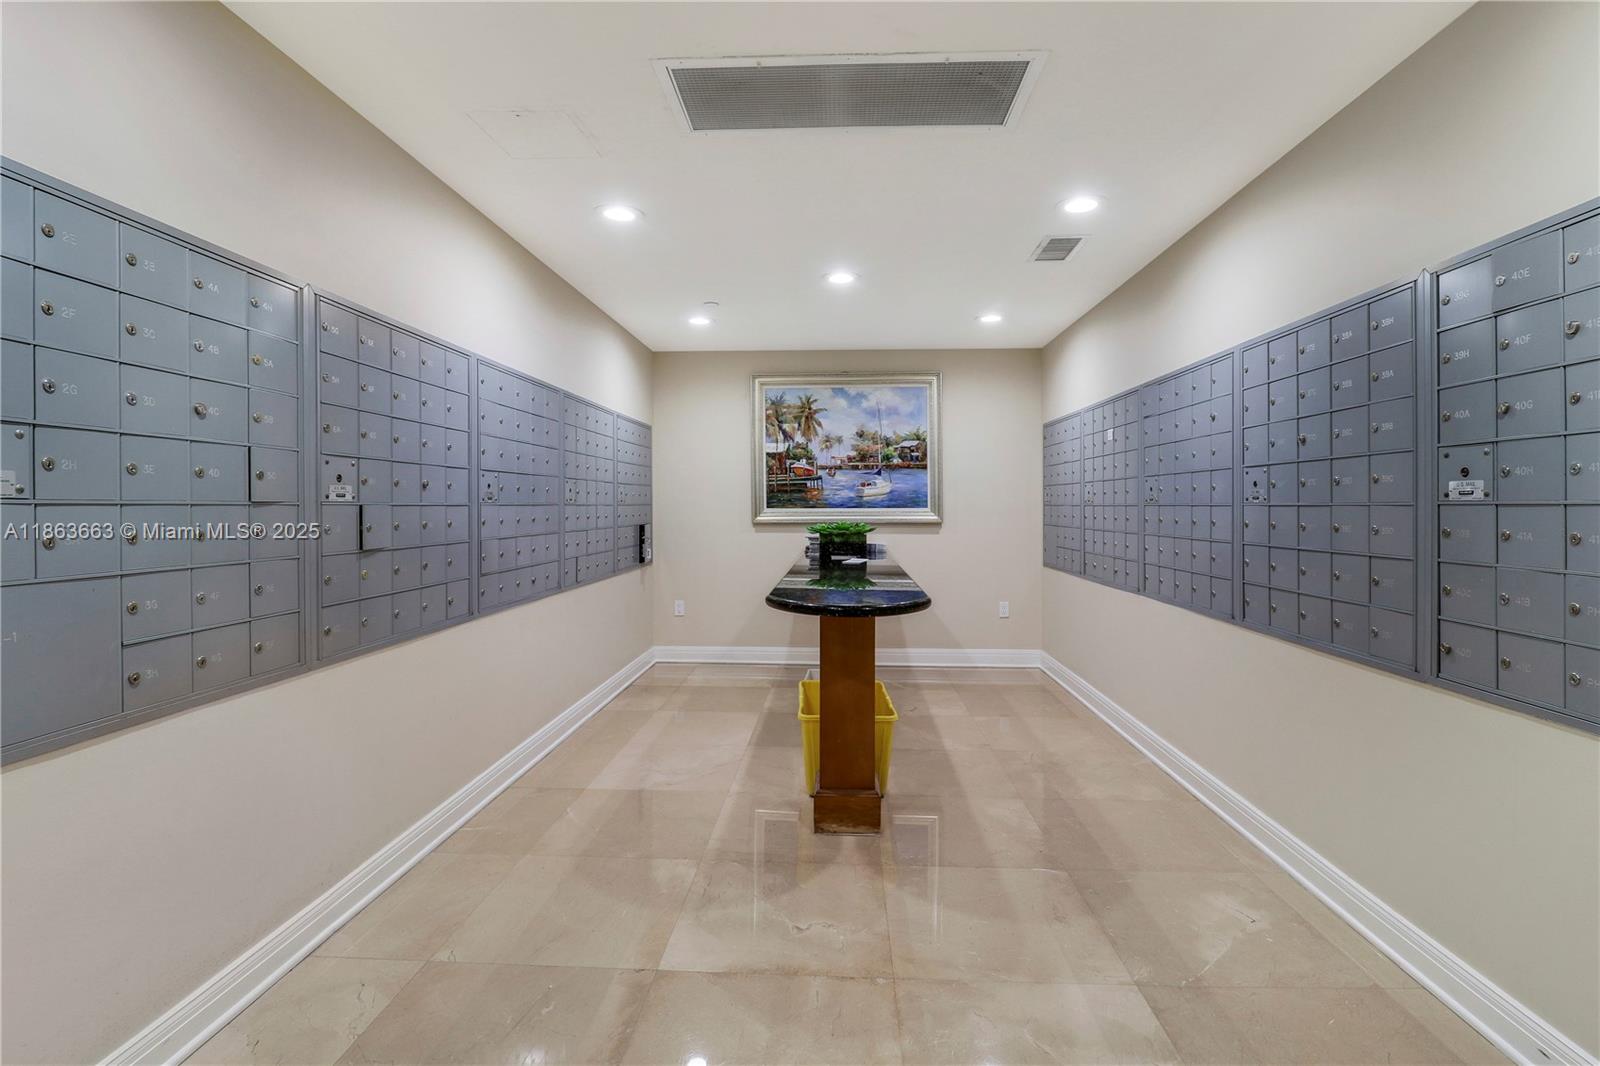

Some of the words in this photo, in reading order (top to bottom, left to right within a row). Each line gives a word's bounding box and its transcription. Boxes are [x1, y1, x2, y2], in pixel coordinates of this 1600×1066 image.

[62, 232, 77, 246] 2E
[1512, 267, 1530, 280] 40E
[208, 283, 220, 294] 4A
[62, 306, 76, 318] 2F
[1514, 334, 1531, 346] 40F
[1454, 349, 1470, 360] 39H
[62, 383, 78, 395] 2G
[1514, 400, 1533, 410] 40G
[1454, 410, 1470, 419] 40A
[62, 460, 78, 470] 2H
[1514, 466, 1534, 476] 40H
